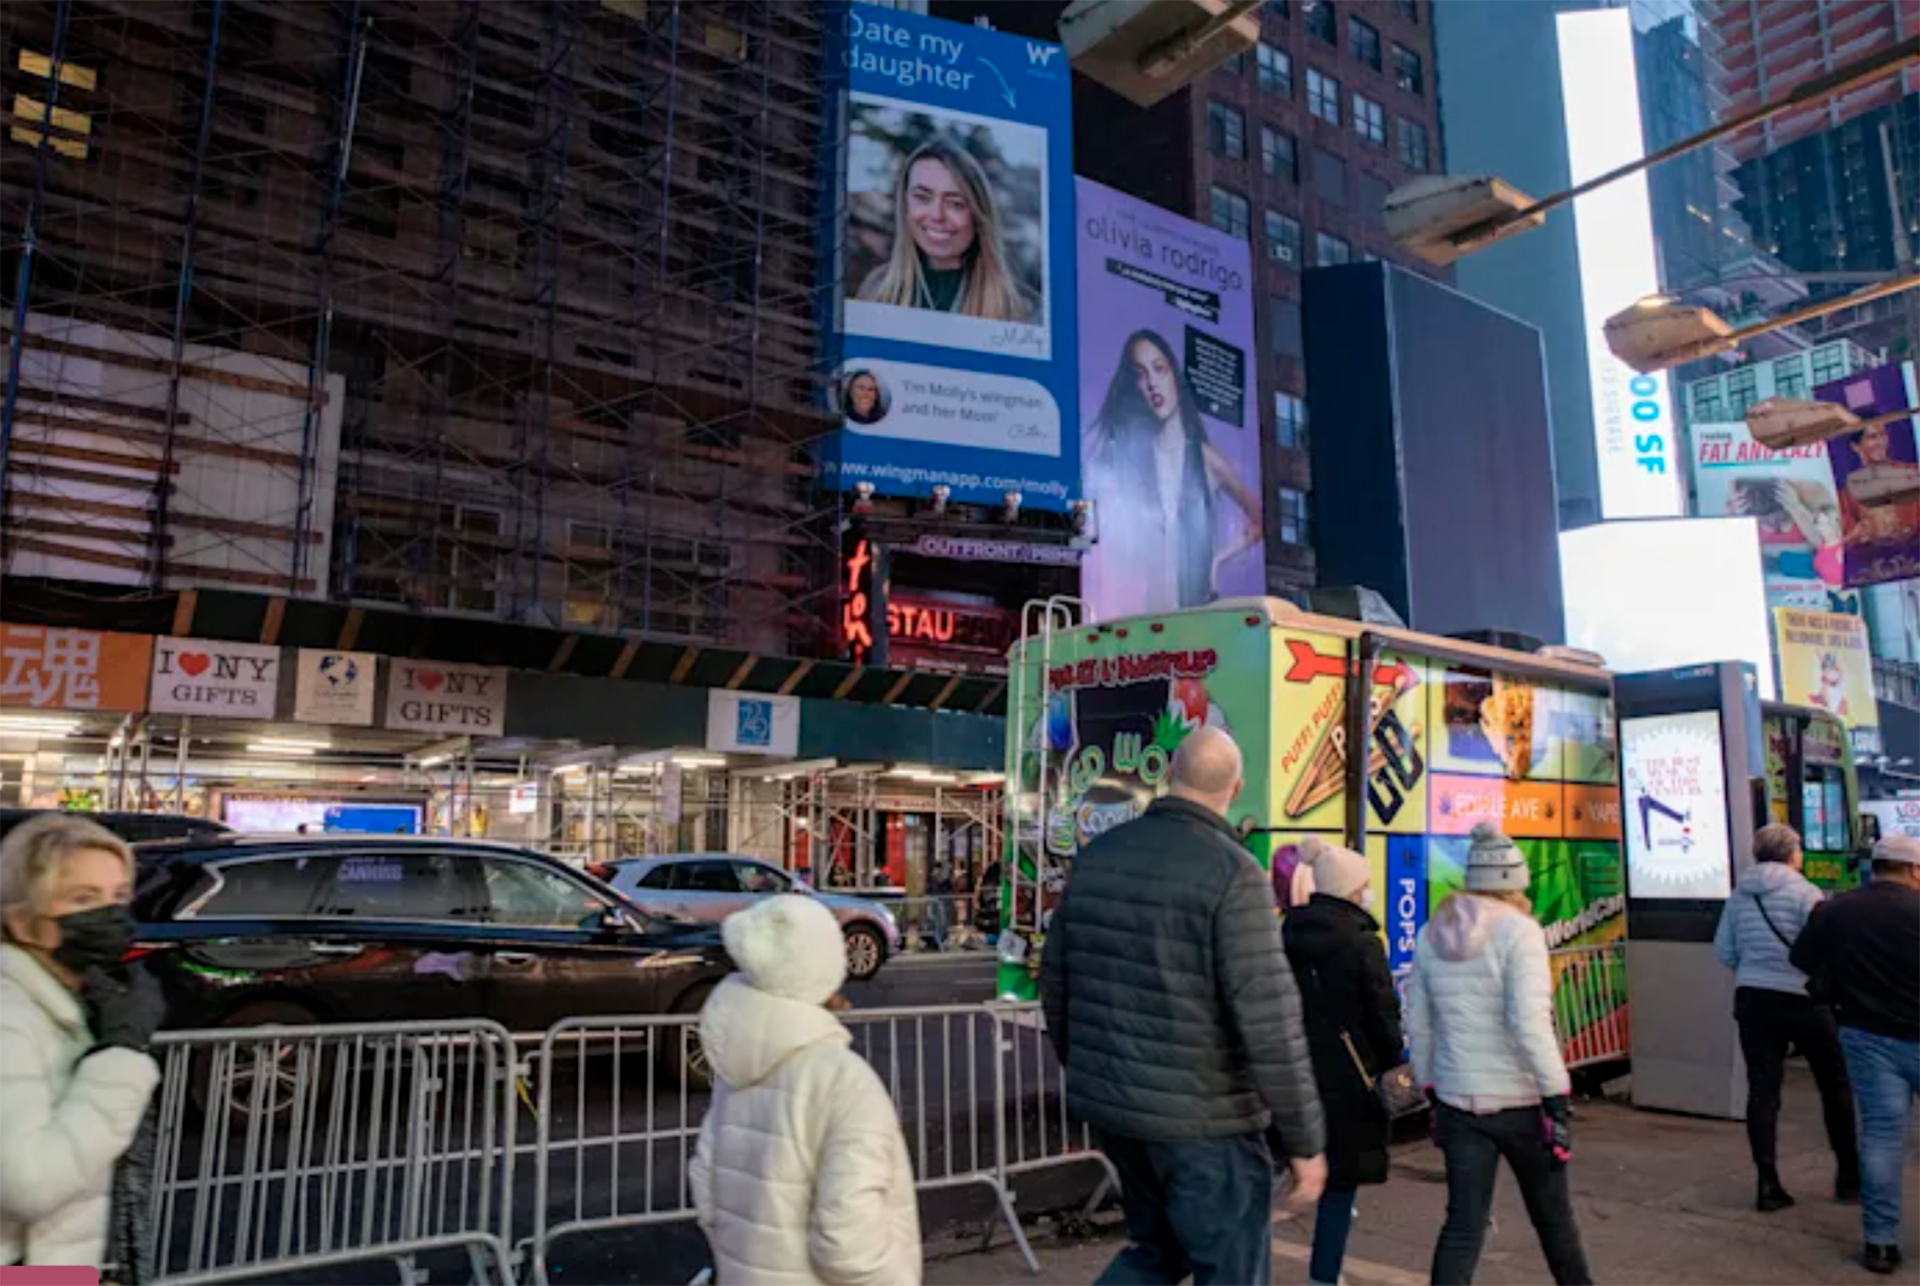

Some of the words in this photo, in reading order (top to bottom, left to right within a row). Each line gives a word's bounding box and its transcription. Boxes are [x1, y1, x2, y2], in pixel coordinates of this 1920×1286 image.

[920, 34, 963, 63] my
[842, 45, 974, 90] daughter
[1086, 216, 1152, 259] olivia
[1161, 245, 1243, 291] rodrigo
[902, 402, 929, 416] and
[932, 404, 956, 418] her
[1635, 434, 1665, 474] SF
[1699, 441, 1731, 462] FAT
[0, 627, 100, 708] 魂
[158, 651, 174, 673] I
[214, 654, 274, 682] NY
[403, 667, 414, 689] I
[444, 671, 494, 696] NY
[172, 684, 258, 705] GIFTS
[401, 702, 491, 727] GIFTS
[1399, 878, 1415, 953] POPS
